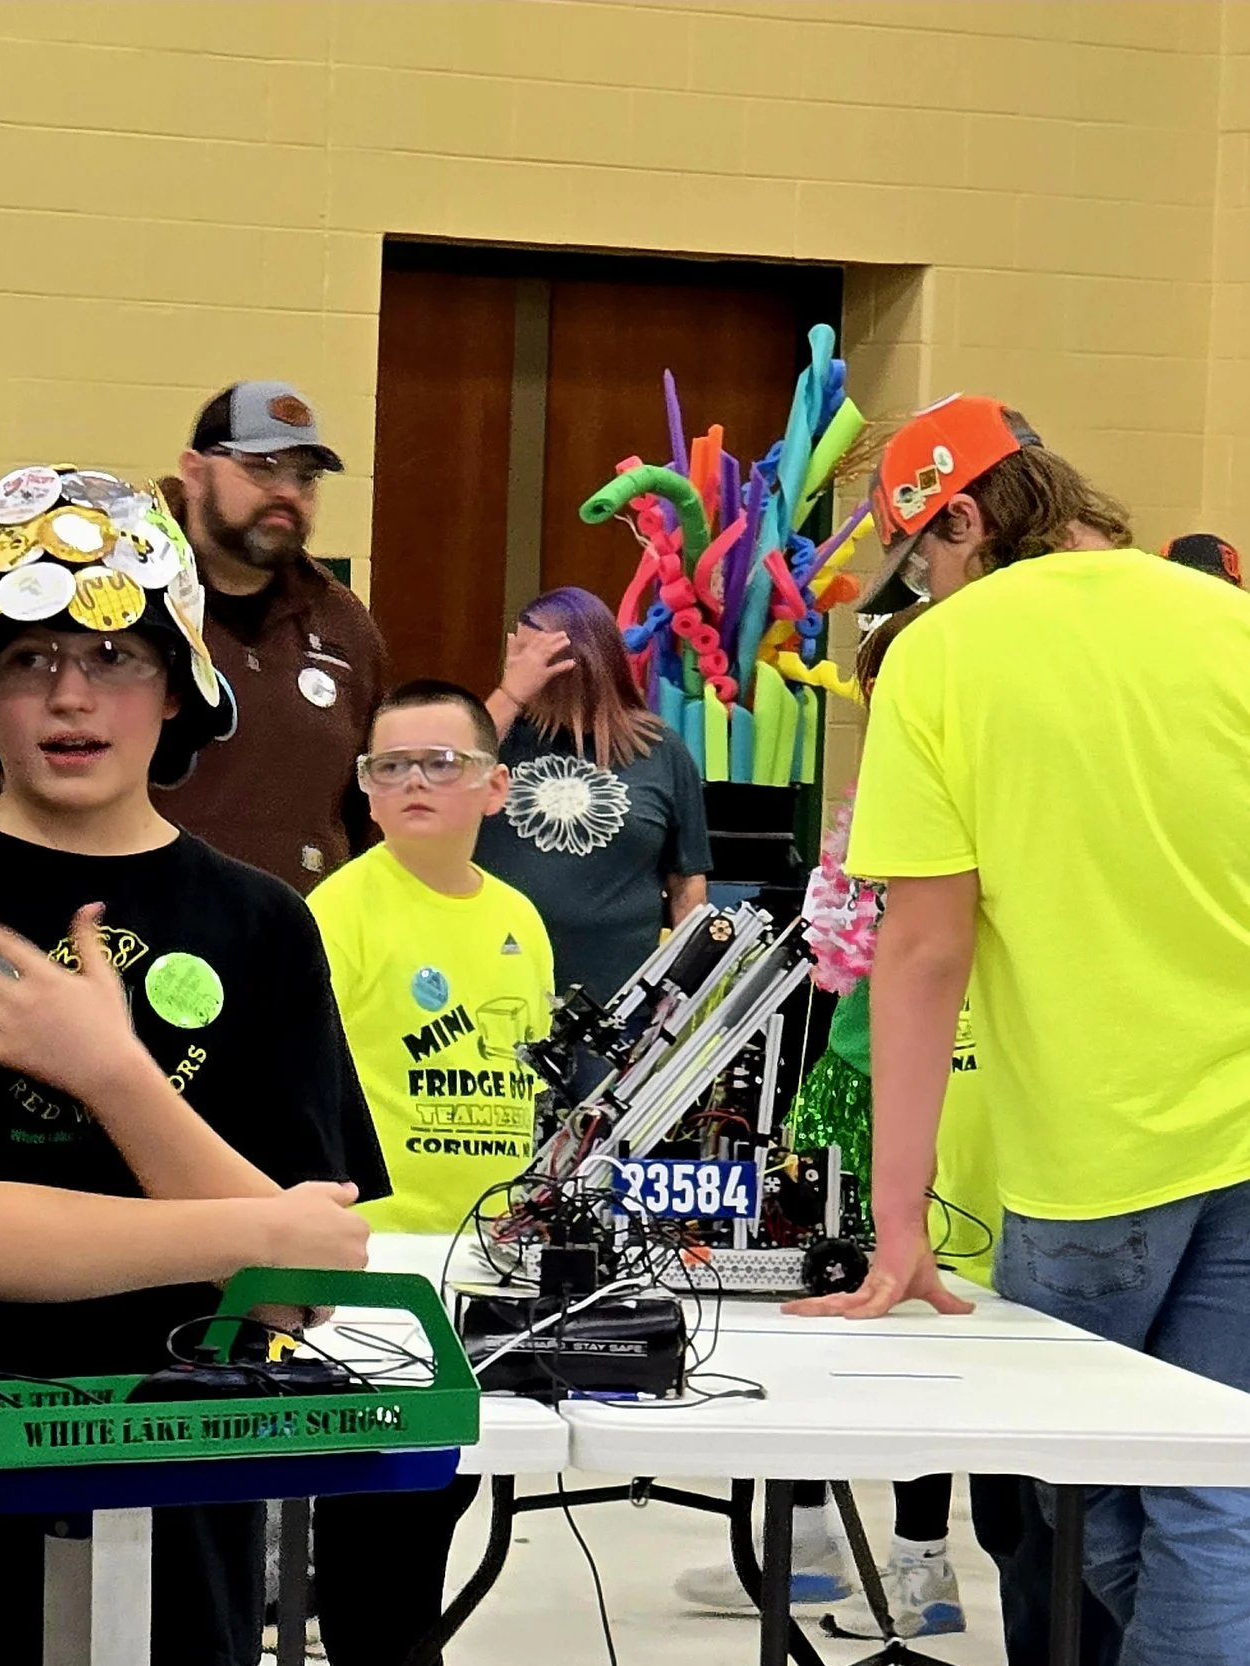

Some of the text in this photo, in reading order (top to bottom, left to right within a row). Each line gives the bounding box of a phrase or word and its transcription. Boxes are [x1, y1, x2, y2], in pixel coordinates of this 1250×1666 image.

[402, 1004, 475, 1063] MINI
[408, 1069, 506, 1097] FRIDGE
[416, 1103, 493, 1126] TEAM
[622, 1163, 749, 1215] 23584
[23, 1403, 407, 1448] WHITE LAKE MIDDLE SCHOOL
